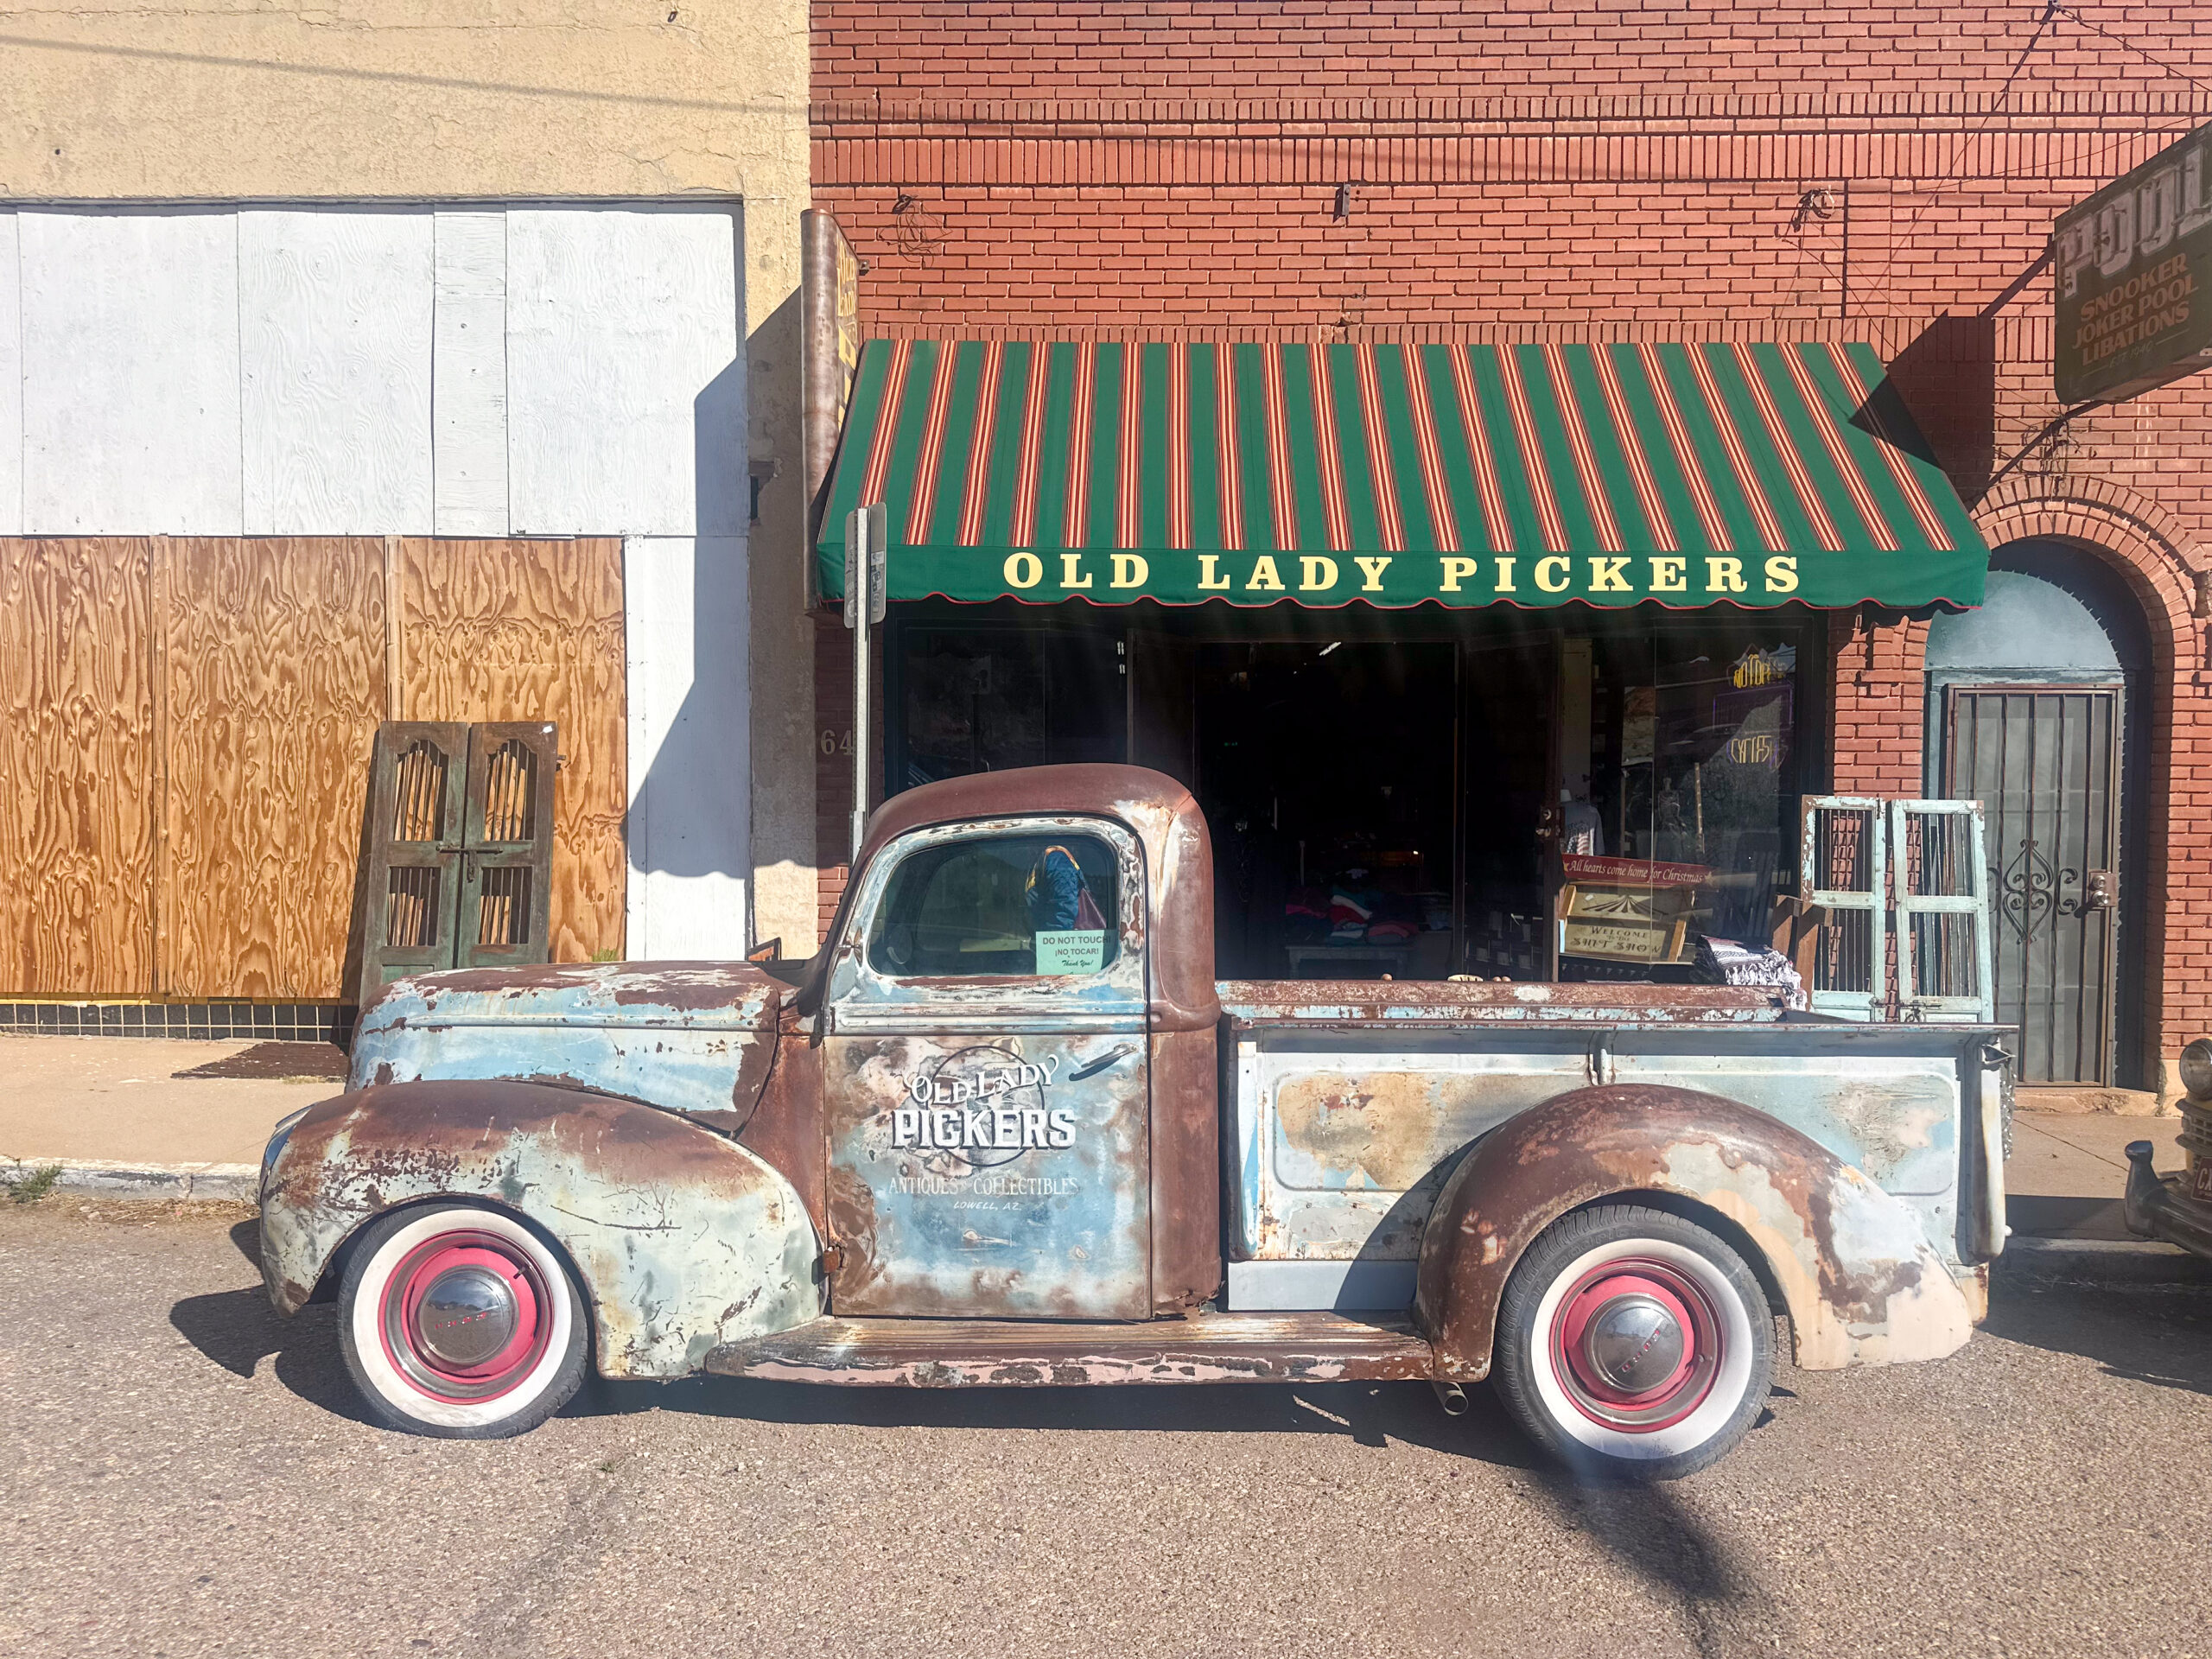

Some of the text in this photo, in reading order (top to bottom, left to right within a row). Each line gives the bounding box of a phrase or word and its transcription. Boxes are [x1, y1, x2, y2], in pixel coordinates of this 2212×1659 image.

[2056, 145, 2212, 299] POOL
[2080, 253, 2190, 323] SNOOKER
[2072, 274, 2199, 350] JOKER POOL
[2082, 301, 2190, 366] LIBATIONS
[1003, 551, 1800, 594] OLD LADY PICKERS
[1569, 860, 1704, 884] All hearts come home for Christmas
[1079, 959, 1094, 968] You!
[905, 1054, 1059, 1105] OLD LADY
[891, 1109, 1077, 1149] PICKERS
[888, 1176, 958, 1196] ANTIQUES
[973, 1176, 1078, 1196] COLLECTIBLES
[953, 1200, 999, 1211] LOWELL,
